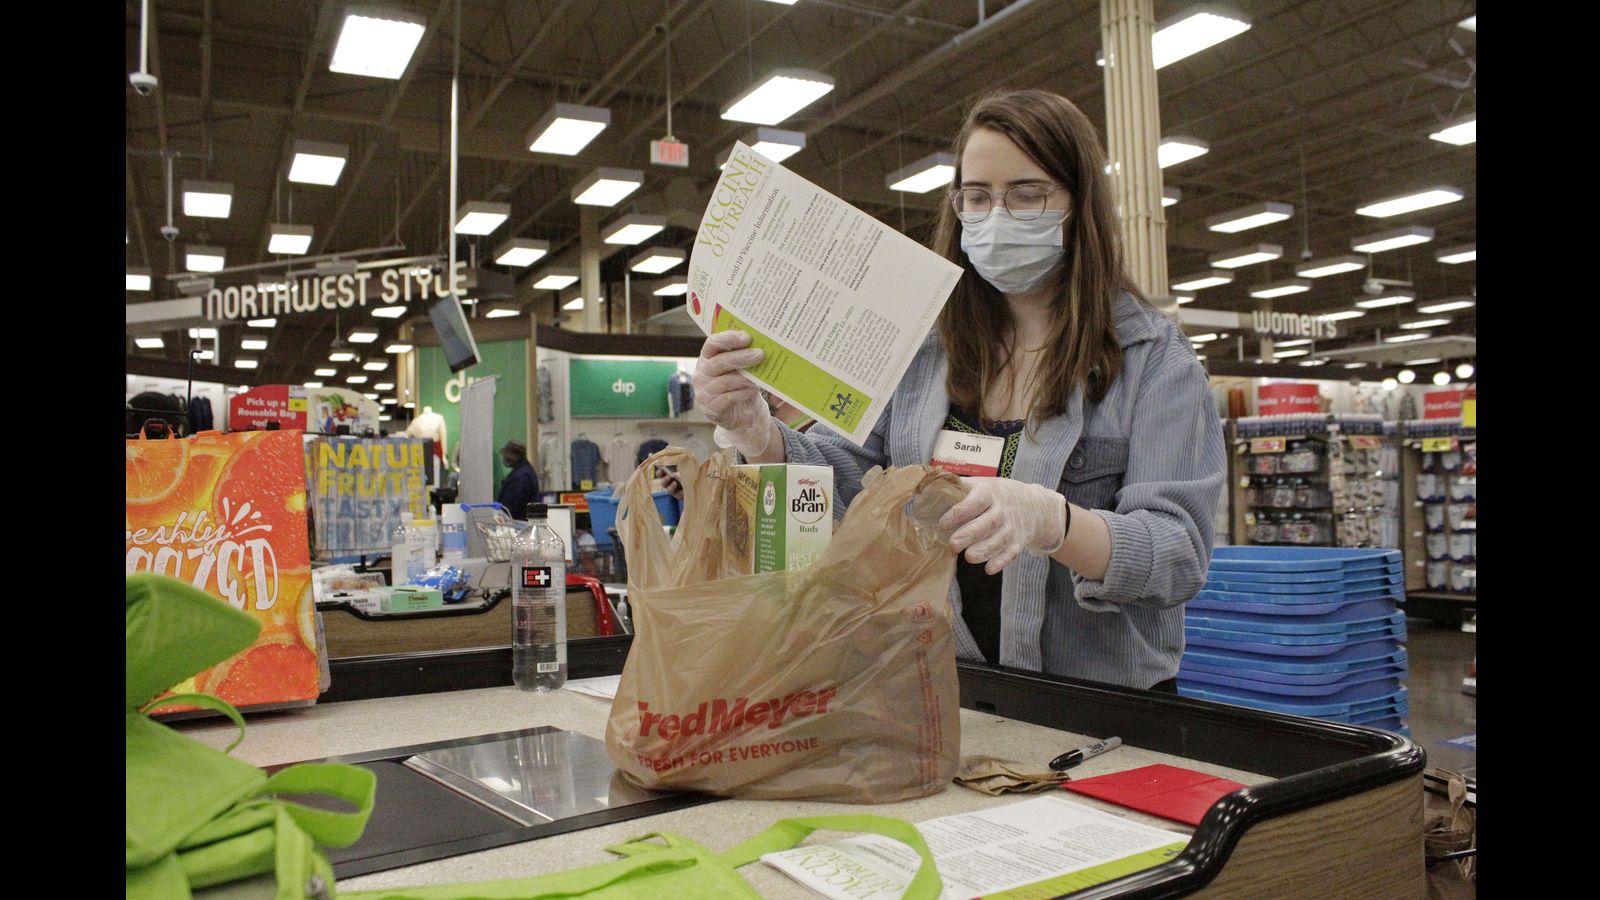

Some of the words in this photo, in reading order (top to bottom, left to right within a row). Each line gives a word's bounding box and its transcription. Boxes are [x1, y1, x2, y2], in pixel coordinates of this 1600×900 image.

[660, 143, 683, 161] EXIT
[698, 148, 754, 244] VACCINE
[708, 158, 766, 257] OUTREACH
[726, 254, 744, 286] Covid-19
[739, 227, 758, 255] Vaccine
[753, 186, 779, 228] Information
[207, 272, 371, 321] NORTHWEST
[381, 260, 467, 304] STYLE
[1253, 310, 1337, 338] women's
[612, 379, 635, 396] dip
[238, 408, 277, 418] Reusable
[280, 409, 296, 419] Bag
[246, 397, 265, 407] Pick
[267, 399, 278, 408] up
[954, 442, 982, 453] Sarah
[320, 470, 405, 496] FRUIT
[792, 498, 824, 513] Bran
[126, 510, 232, 555] eshly
[799, 525, 818, 533] Buds
[708, 686, 837, 736] Meyer
[691, 751, 723, 766] FOR
[729, 737, 819, 763] EVERYONE
